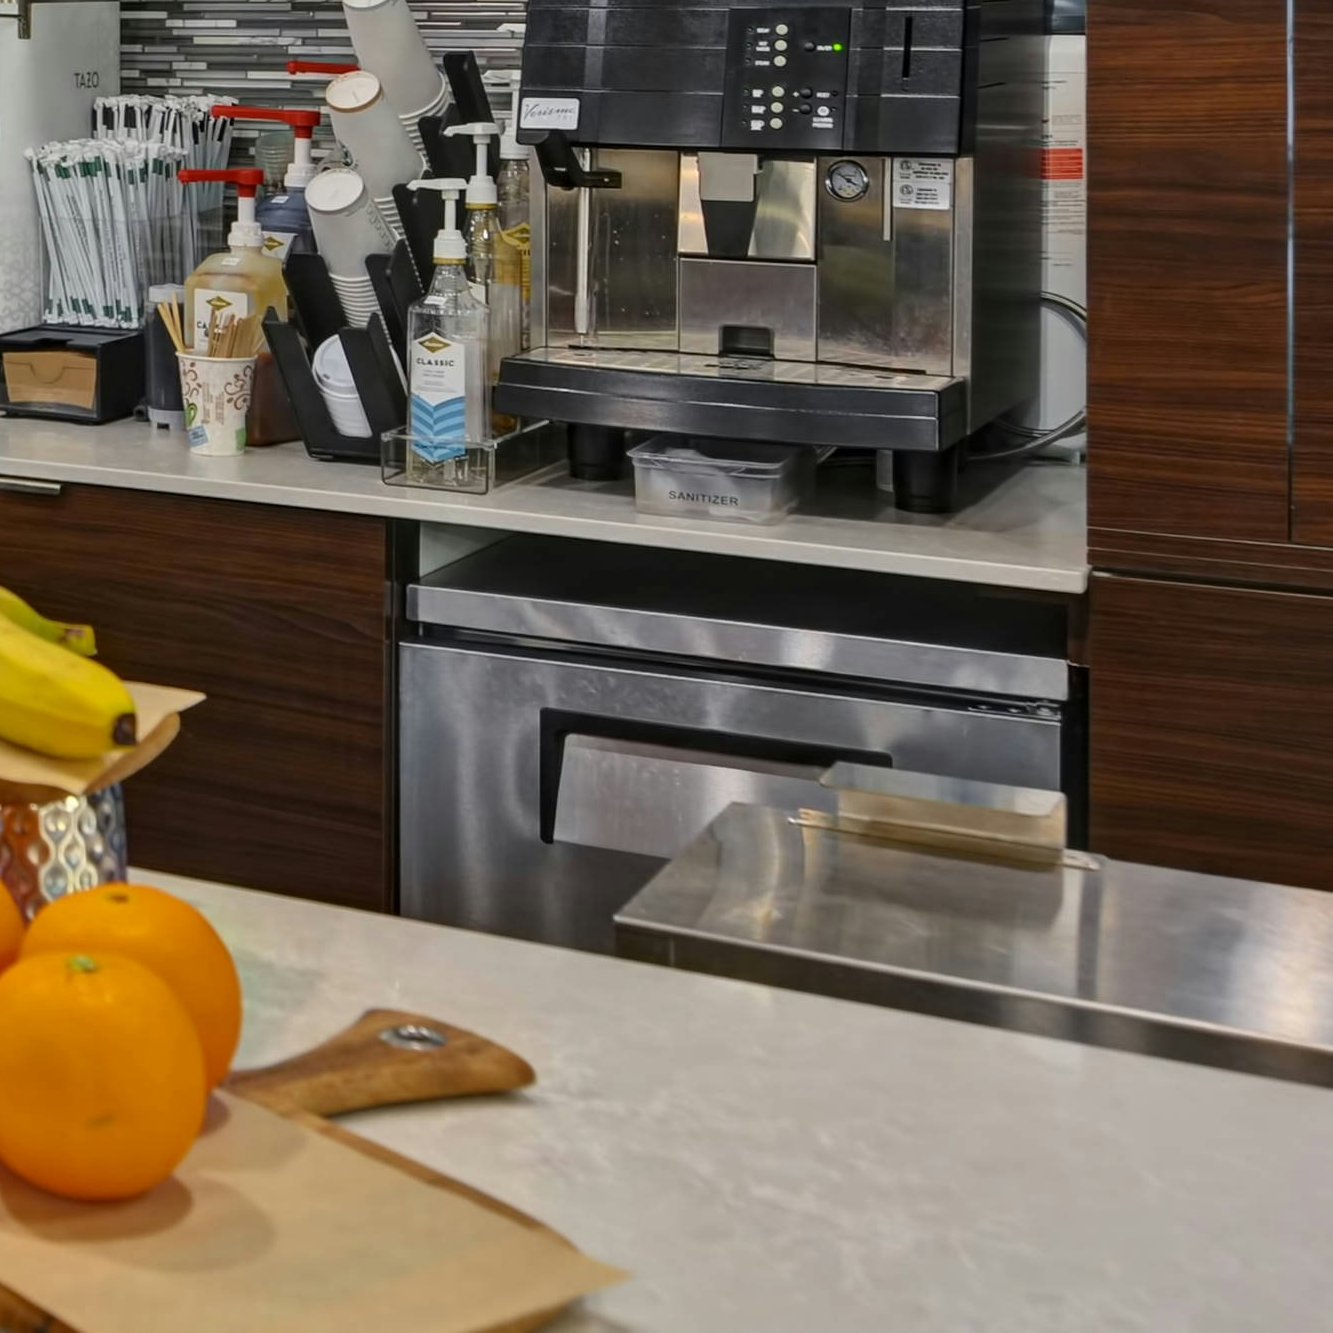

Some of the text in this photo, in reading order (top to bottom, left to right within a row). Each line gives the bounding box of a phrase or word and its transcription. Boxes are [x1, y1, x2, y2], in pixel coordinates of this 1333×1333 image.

[73, 70, 100, 90] TAZO
[415, 357, 456, 368] CLASSIC
[667, 489, 740, 507] SANITIZER
